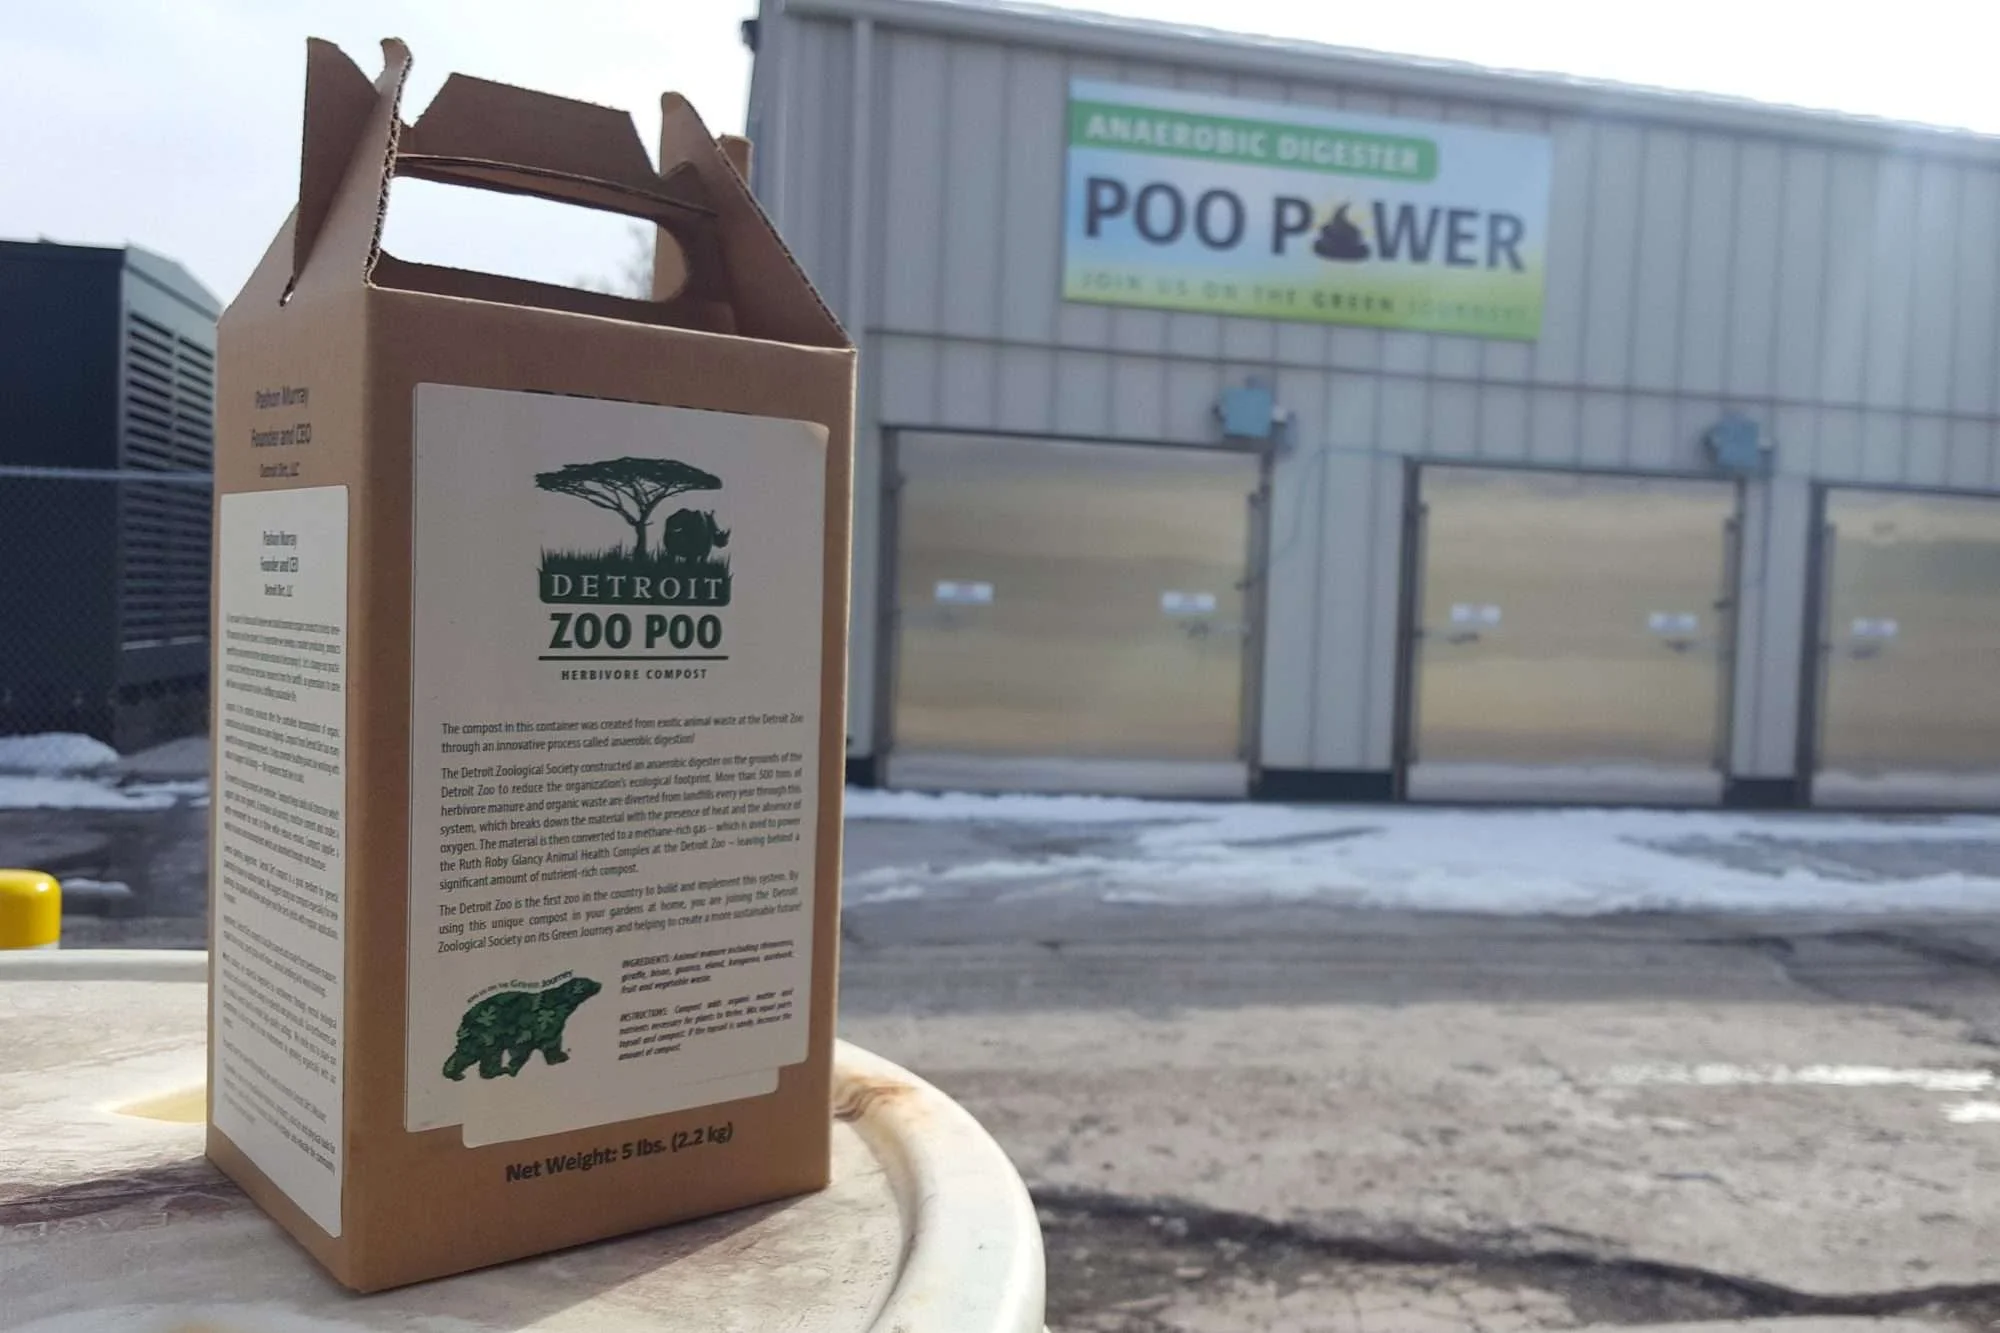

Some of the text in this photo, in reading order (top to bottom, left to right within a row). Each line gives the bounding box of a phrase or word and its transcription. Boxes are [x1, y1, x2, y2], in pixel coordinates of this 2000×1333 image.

[1084, 113, 1420, 174] ANAEROBIC DIGESTER
[1083, 176, 1526, 272] POO PWER
[1312, 289, 1394, 312] GREEN
[552, 574, 722, 599] DETROIT
[549, 612, 722, 649] ZOO POO
[562, 669, 707, 680] HERBIVORE COMPOST
[442, 723, 458, 734] The
[462, 723, 501, 736] compost
[505, 723, 515, 733] in
[516, 722, 534, 733] this
[536, 722, 579, 732] container
[581, 722, 598, 730] was
[600, 719, 633, 730] created
[635, 718, 656, 729] from
[748, 714, 761, 724] the
[762, 714, 788, 724] Detroit
[441, 741, 480, 754] through
[482, 743, 493, 751] an
[497, 740, 546, 750] innovative
[547, 740, 581, 751] process
[583, 736, 609, 747] called
[441, 768, 458, 778] The
[461, 767, 494, 778] Detroit
[496, 763, 544, 778] Zoological
[546, 763, 578, 775] Society
[580, 759, 632, 772] constructed
[441, 786, 473, 797] Detroit
[477, 784, 495, 795] Zoo
[499, 784, 508, 794] to
[512, 782, 543, 794] reduce
[547, 781, 561, 792] the
[630, 775, 671, 789] ecological
[715, 772, 735, 782] More
[441, 804, 486, 816] herbivore
[488, 803, 524, 813] manure
[526, 799, 544, 811] and
[546, 798, 579, 812] organic
[581, 797, 607, 807] waste
[716, 789, 737, 799] every
[479, 819, 508, 832] which
[510, 818, 540, 830] breaks
[544, 817, 569, 827] down
[571, 814, 586, 825] the
[588, 811, 624, 824] material
[627, 809, 646, 821] with
[648, 808, 662, 819] the
[664, 808, 700, 821] presence
[711, 805, 730, 815] heat
[440, 842, 477, 855] oxygen.
[479, 838, 497, 849] The
[499, 835, 538, 848] material
[540, 835, 548, 845] is
[549, 833, 570, 844] then
[572, 829, 615, 843] converted
[617, 830, 626, 839] to
[693, 824, 706, 836] gas
[440, 859, 455, 871] the
[459, 857, 481, 870] Ruth
[485, 856, 508, 870] Roby
[511, 855, 543, 868] Glancy
[546, 850, 578, 864] Animal
[581, 847, 610, 860] Health
[613, 845, 649, 859] Complex
[652, 844, 661, 854] at
[664, 842, 677, 853] the
[680, 840, 708, 851] Detroit
[711, 839, 726, 849] Zoo
[440, 875, 488, 892] significant
[490, 872, 527, 885] amount
[530, 870, 538, 882] of
[541, 865, 598, 881] nutrient-rich
[440, 903, 456, 916] The
[459, 901, 492, 914] Detroit
[495, 899, 512, 911] Zoo
[515, 899, 521, 909] is
[525, 896, 541, 908] the
[543, 894, 561, 906] first
[564, 894, 579, 904] zoo
[583, 891, 591, 902] in
[593, 889, 608, 900] the
[611, 886, 643, 898] country
[646, 884, 655, 894] to
[439, 922, 464, 935] using
[469, 919, 486, 931] this
[492, 917, 524, 930] unique
[529, 911, 567, 926] compost
[572, 910, 581, 920] in
[586, 909, 605, 922] your
[609, 903, 643, 919] gardens
[438, 914, 702, 953] Zoological Society on its Green Journey and helping create
[506, 1122, 733, 1182] Net Weight: 5 lbs. (2.2 kg)
